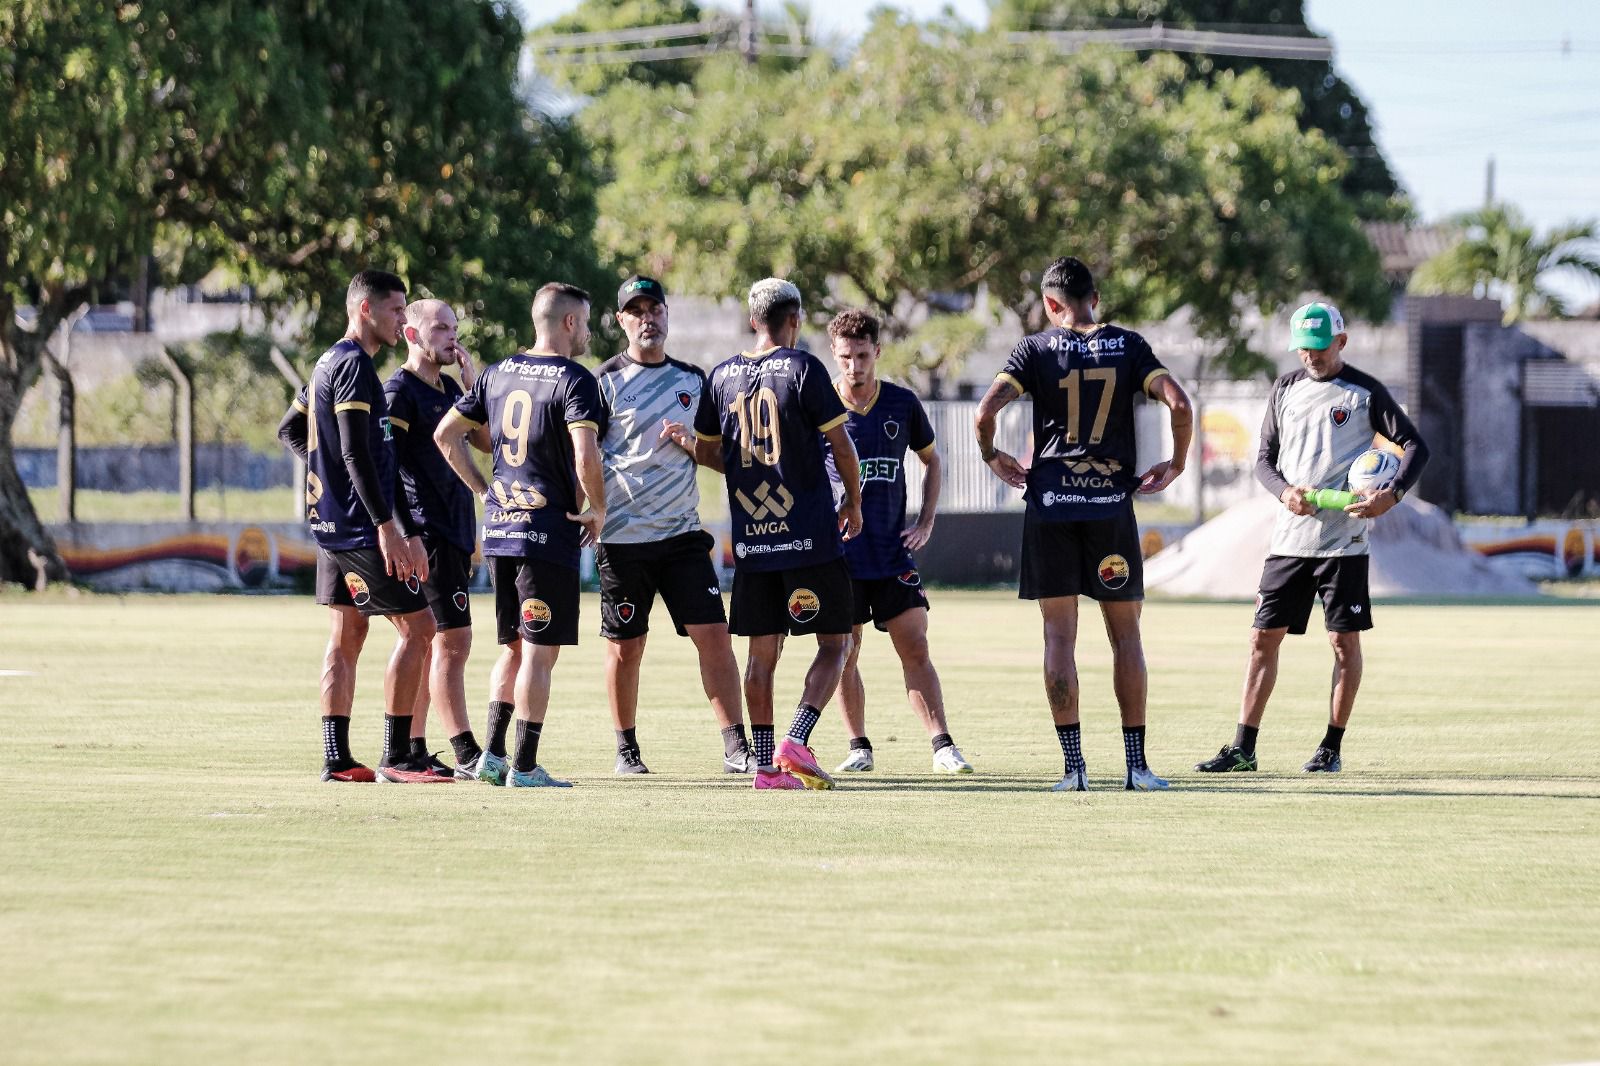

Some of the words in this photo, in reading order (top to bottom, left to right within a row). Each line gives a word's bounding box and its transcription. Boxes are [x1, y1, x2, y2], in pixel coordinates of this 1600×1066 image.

[1058, 334, 1125, 353] brisanet
[504, 357, 566, 378] brisanet
[1058, 366, 1117, 445] 17
[501, 389, 533, 467] 9
[728, 387, 782, 468] 19
[1061, 475, 1114, 489] LWGA
[1055, 493, 1087, 503] CAGEPA
[491, 511, 533, 524] LWGA
[745, 521, 790, 536] LWGA
[746, 543, 771, 554] CAGEPA
